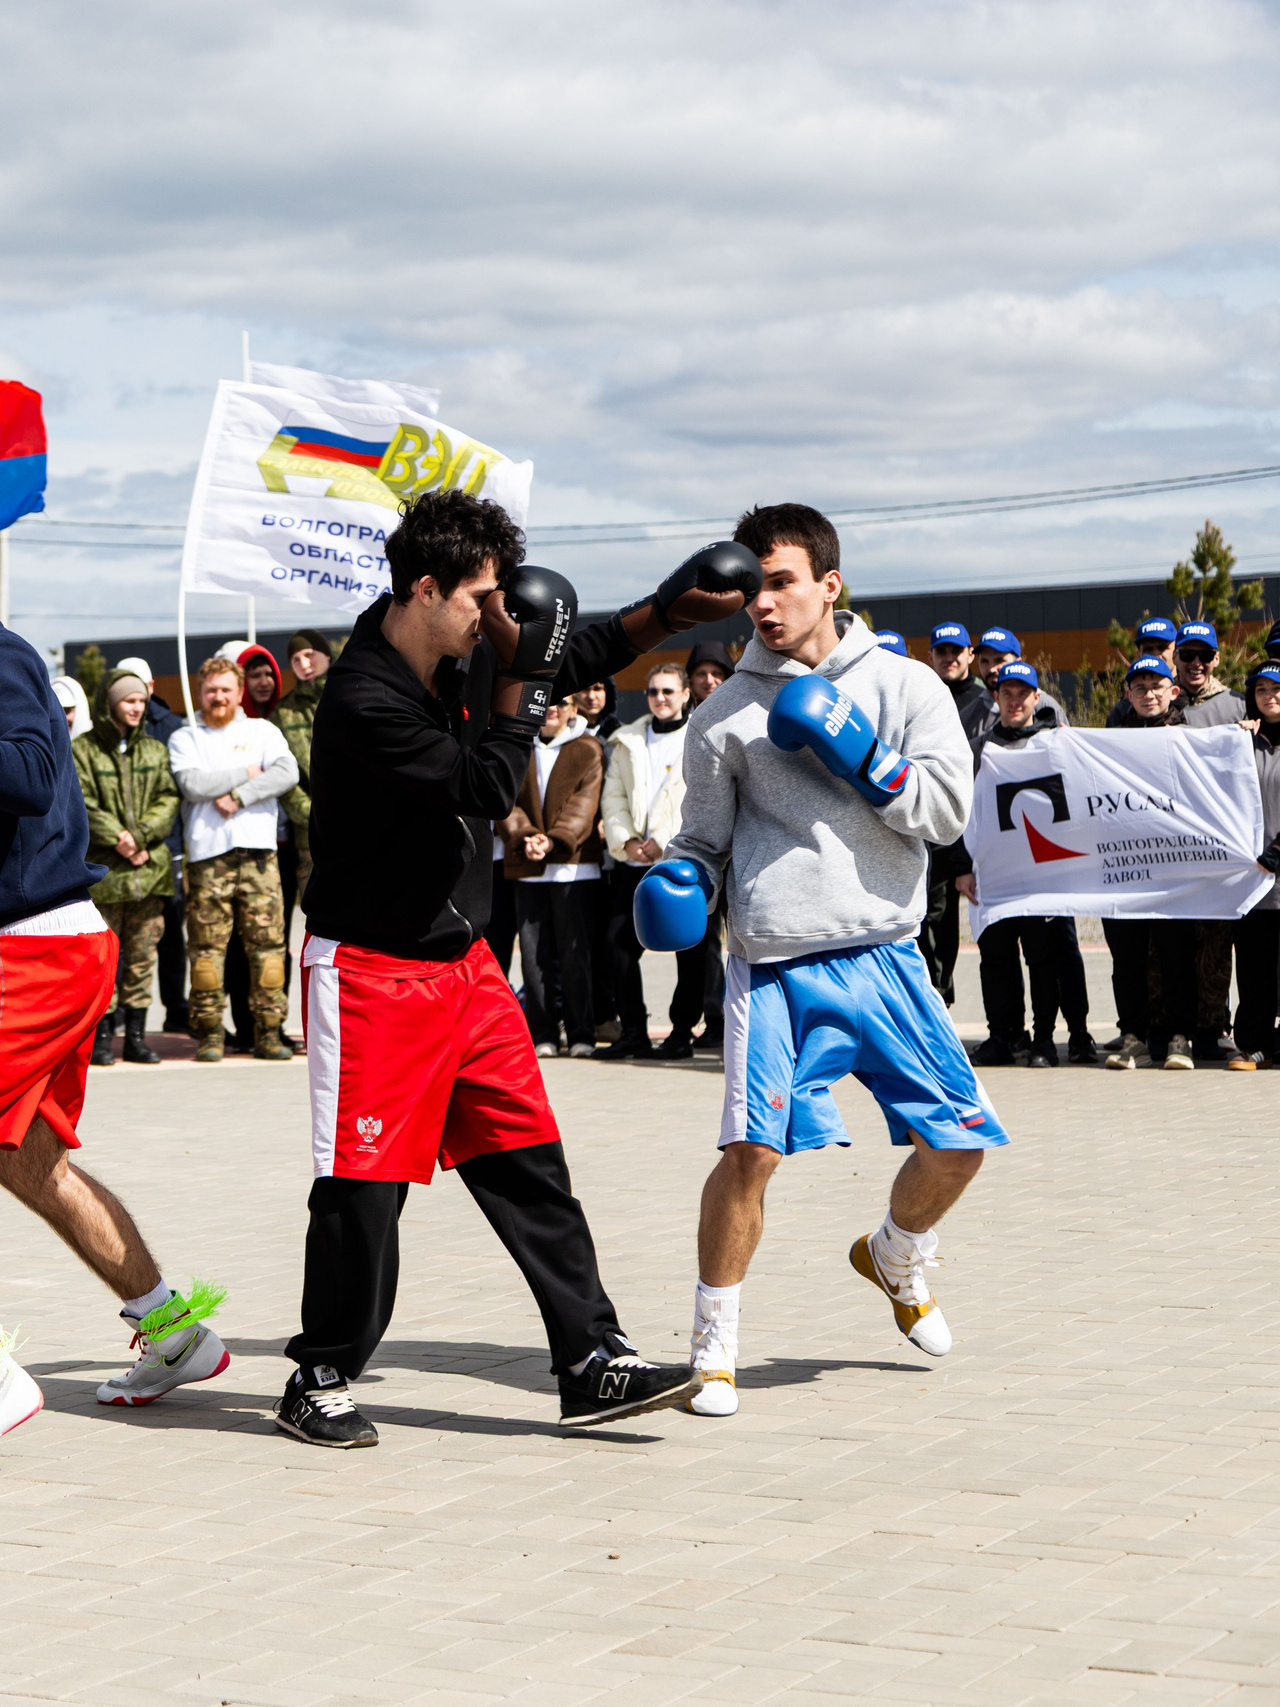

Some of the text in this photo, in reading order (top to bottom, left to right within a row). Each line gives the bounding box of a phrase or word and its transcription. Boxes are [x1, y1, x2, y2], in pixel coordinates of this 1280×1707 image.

[376, 423, 503, 498] ВЭП
[289, 542, 392, 573] ОБЛАСТ
[544, 597, 565, 663] GREEN
[555, 607, 571, 656] HILL
[935, 626, 961, 639] ГМПР
[1141, 622, 1168, 634] ГМПР
[1183, 625, 1210, 636] ГМПР
[877, 634, 899, 645] МПР
[981, 631, 1007, 642] ГМПР
[1005, 664, 1032, 676] ГМПР
[1133, 658, 1160, 671] ГМПР
[1102, 849, 1228, 869] АЛЮМИНИЕВЫЙ
[1103, 869, 1152, 885] ЗАВОД
[598, 1373, 630, 1399] N
[290, 1398, 313, 1428] N
